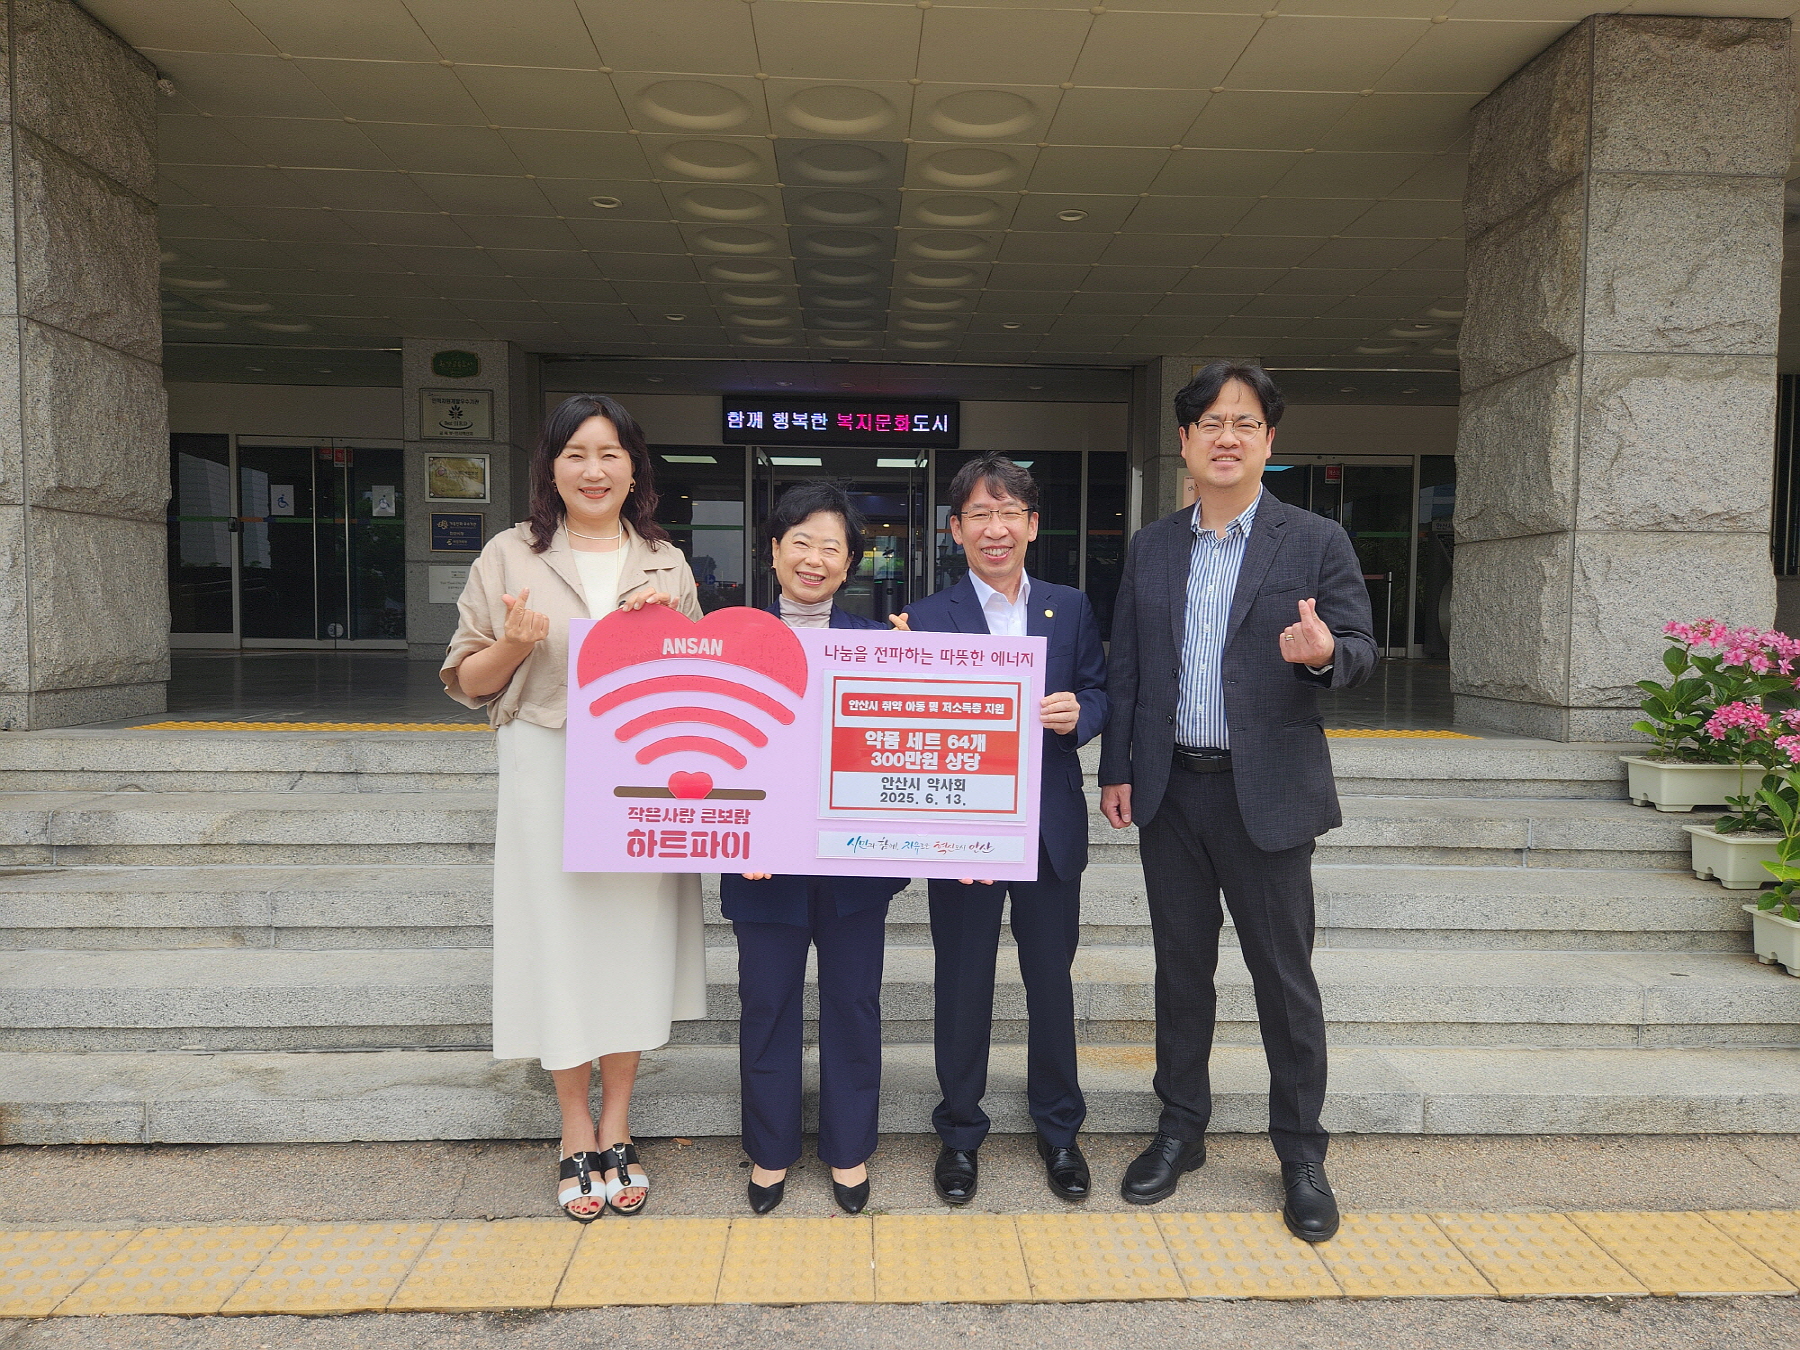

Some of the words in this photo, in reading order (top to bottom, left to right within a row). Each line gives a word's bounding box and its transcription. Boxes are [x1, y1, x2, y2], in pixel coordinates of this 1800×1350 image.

[727, 410, 764, 429] 함께
[772, 411, 829, 431] 행복한
[836, 413, 949, 433] 복지문화도시
[662, 637, 724, 656] ANSAN
[824, 645, 868, 663] 나눔을
[874, 646, 934, 665] 전파하는
[940, 648, 985, 667] 따뜻한
[990, 651, 1034, 667] 에너지
[848, 699, 879, 711] 안산시
[881, 700, 903, 712] 취약
[905, 701, 925, 712] 아동
[929, 701, 939, 713] 및
[942, 702, 982, 714] 저소득층
[984, 703, 1005, 715] 지원
[865, 730, 900, 750] 약품
[906, 731, 942, 751] 세트
[947, 733, 987, 752] 64개
[870, 751, 939, 770] 300만원
[945, 752, 981, 772] 상당
[881, 776, 921, 791] 안산시
[926, 777, 966, 792] 약사회
[880, 792, 919, 805] 2025.
[925, 793, 939, 806] 6.
[945, 793, 967, 806] 13.
[627, 806, 696, 824] 작은사랑
[700, 808, 752, 825] 큰보람
[626, 828, 750, 860] 하트파이
[846, 836, 876, 854] 시민과
[901, 840, 930, 855] 자유로운
[932, 841, 967, 855] 혁신도시
[968, 840, 996, 854] 안산
